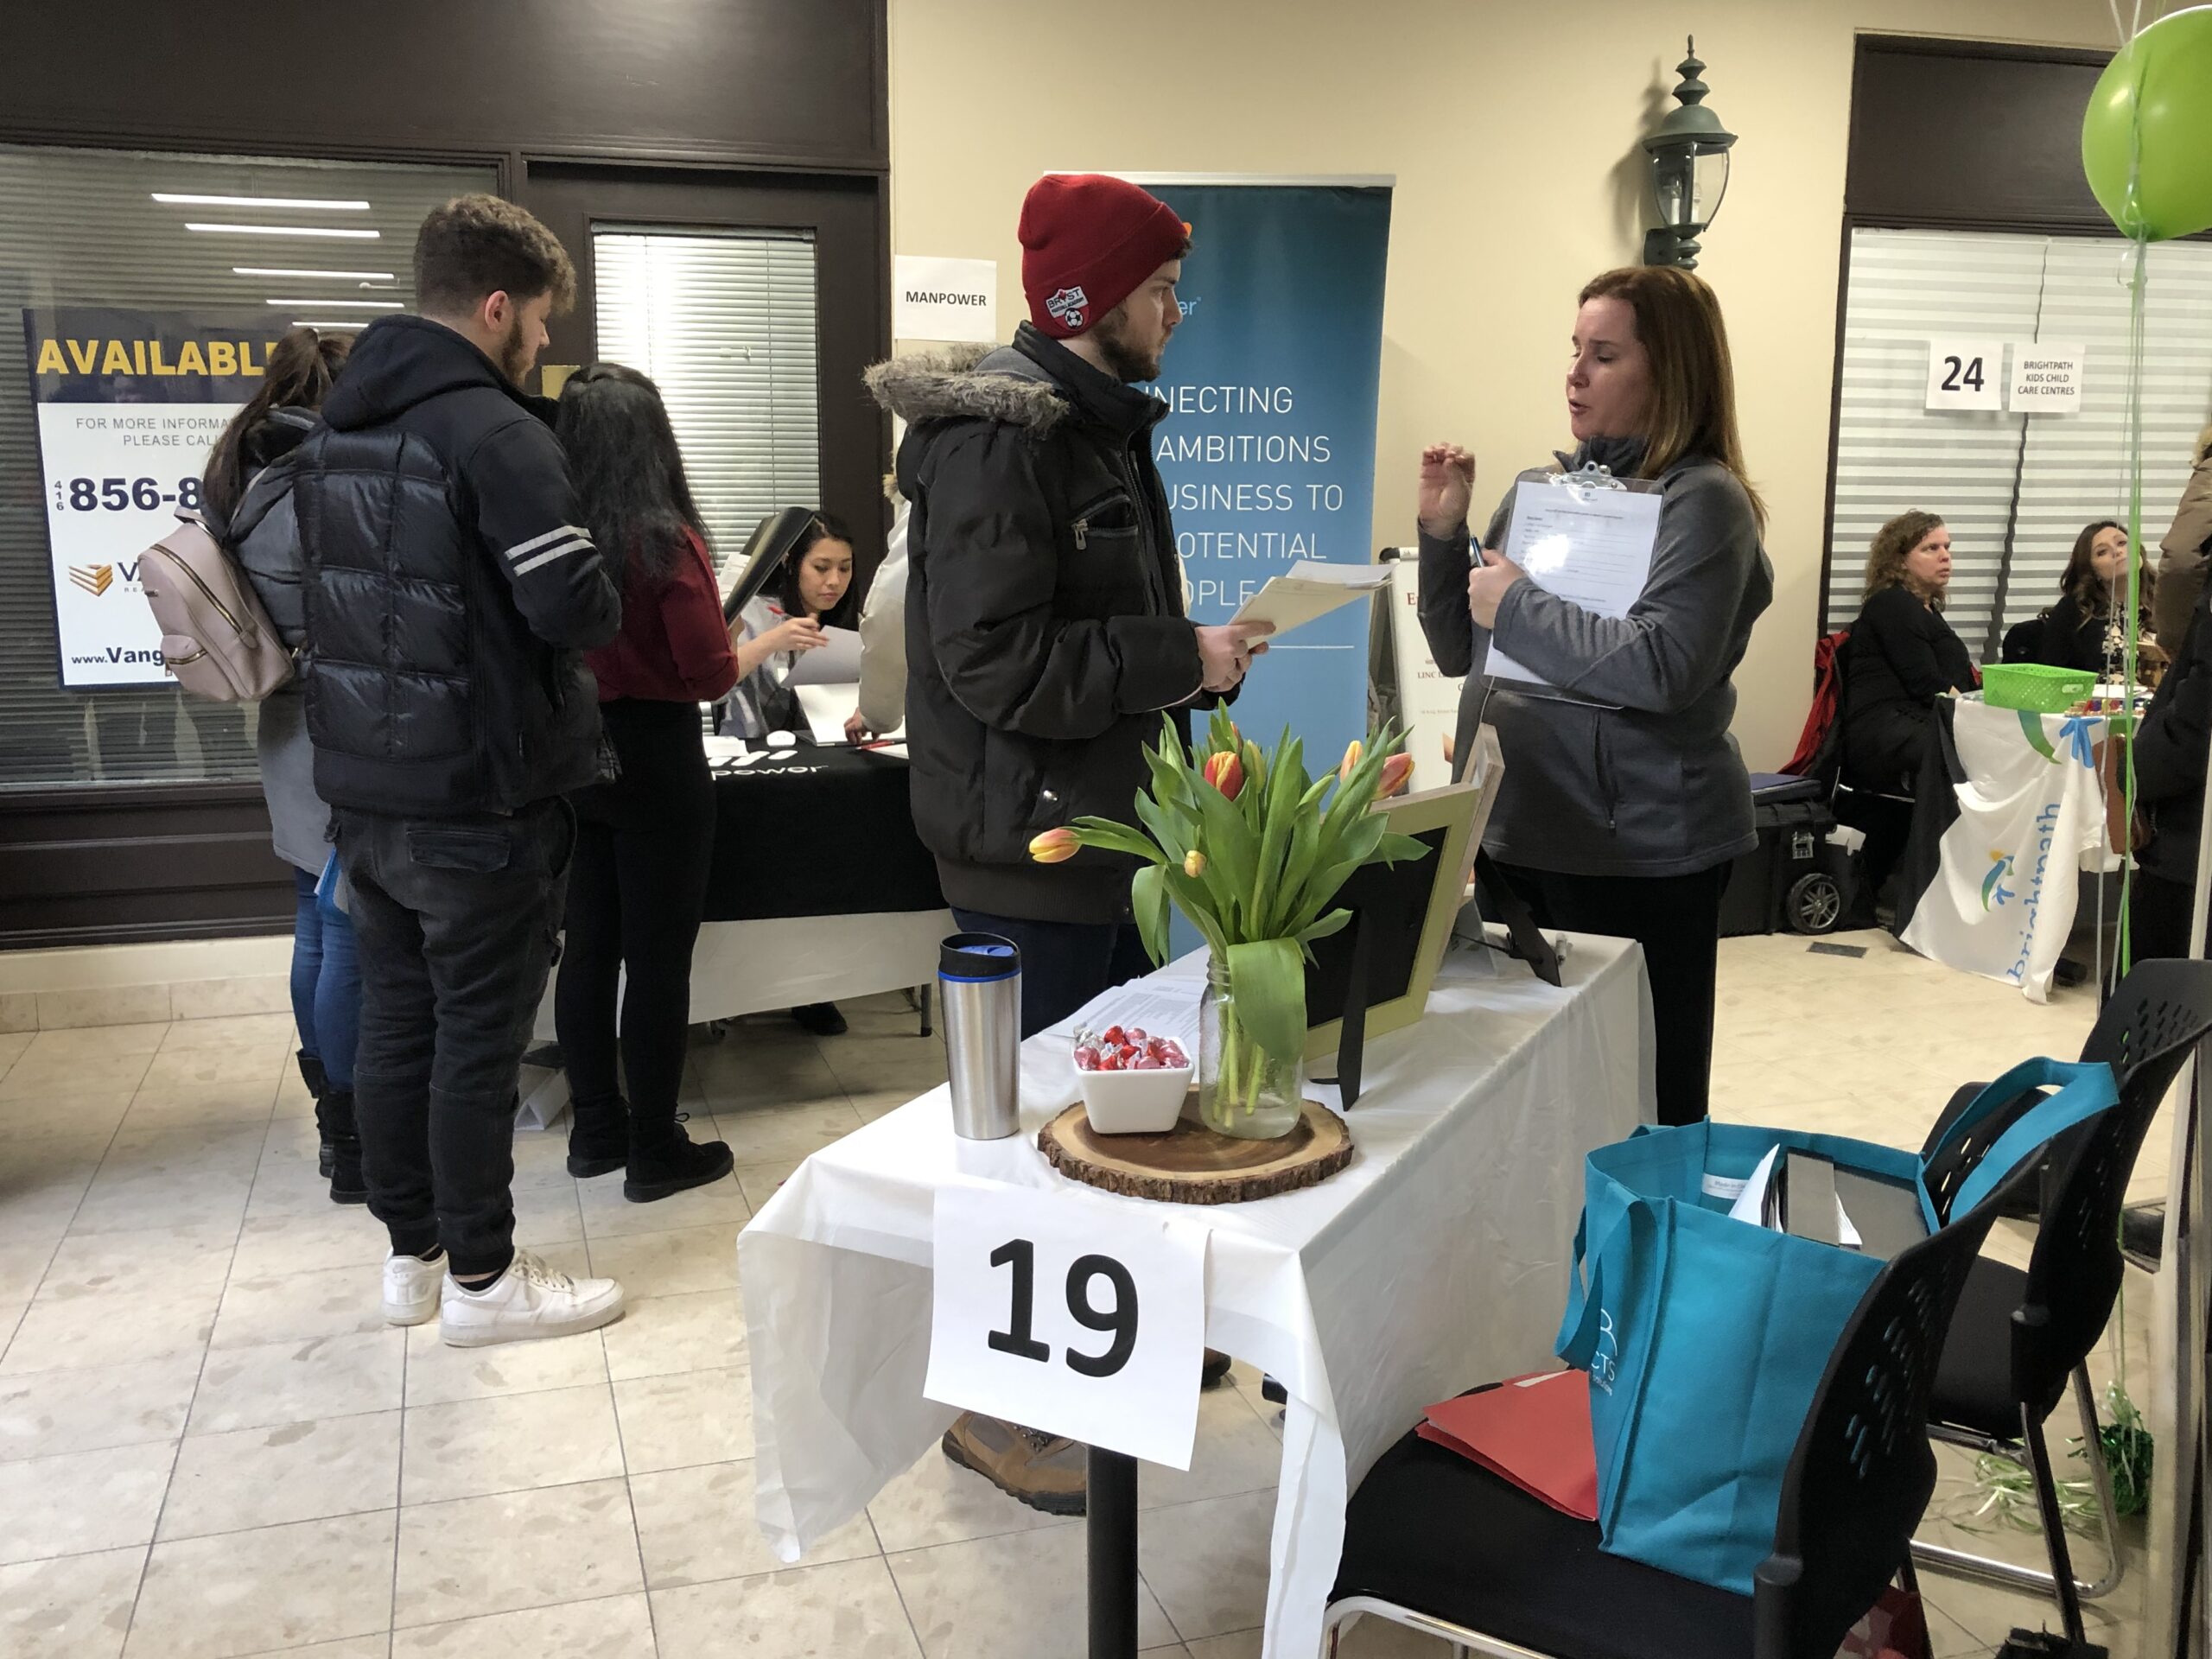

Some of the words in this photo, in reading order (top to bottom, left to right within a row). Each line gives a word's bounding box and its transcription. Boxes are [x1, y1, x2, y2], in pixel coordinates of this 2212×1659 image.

[905, 290, 987, 307] MANPOWER
[1941, 355, 1985, 391] 24
[2024, 360, 2074, 371] BRIGHTPATH
[2025, 373, 2044, 382] KIDS
[2045, 373, 2070, 383] CHILD
[2018, 385, 2039, 395] CARE
[2040, 386, 2075, 396] CENTRES
[76, 418, 107, 429] FOR
[112, 418, 156, 429] MORE
[124, 435, 181, 446] PLEASE
[1155, 435, 1332, 463] AMBITIONS
[1306, 484, 1344, 512] TO
[117, 562, 142, 582] V
[988, 1238, 1139, 1378] 19
